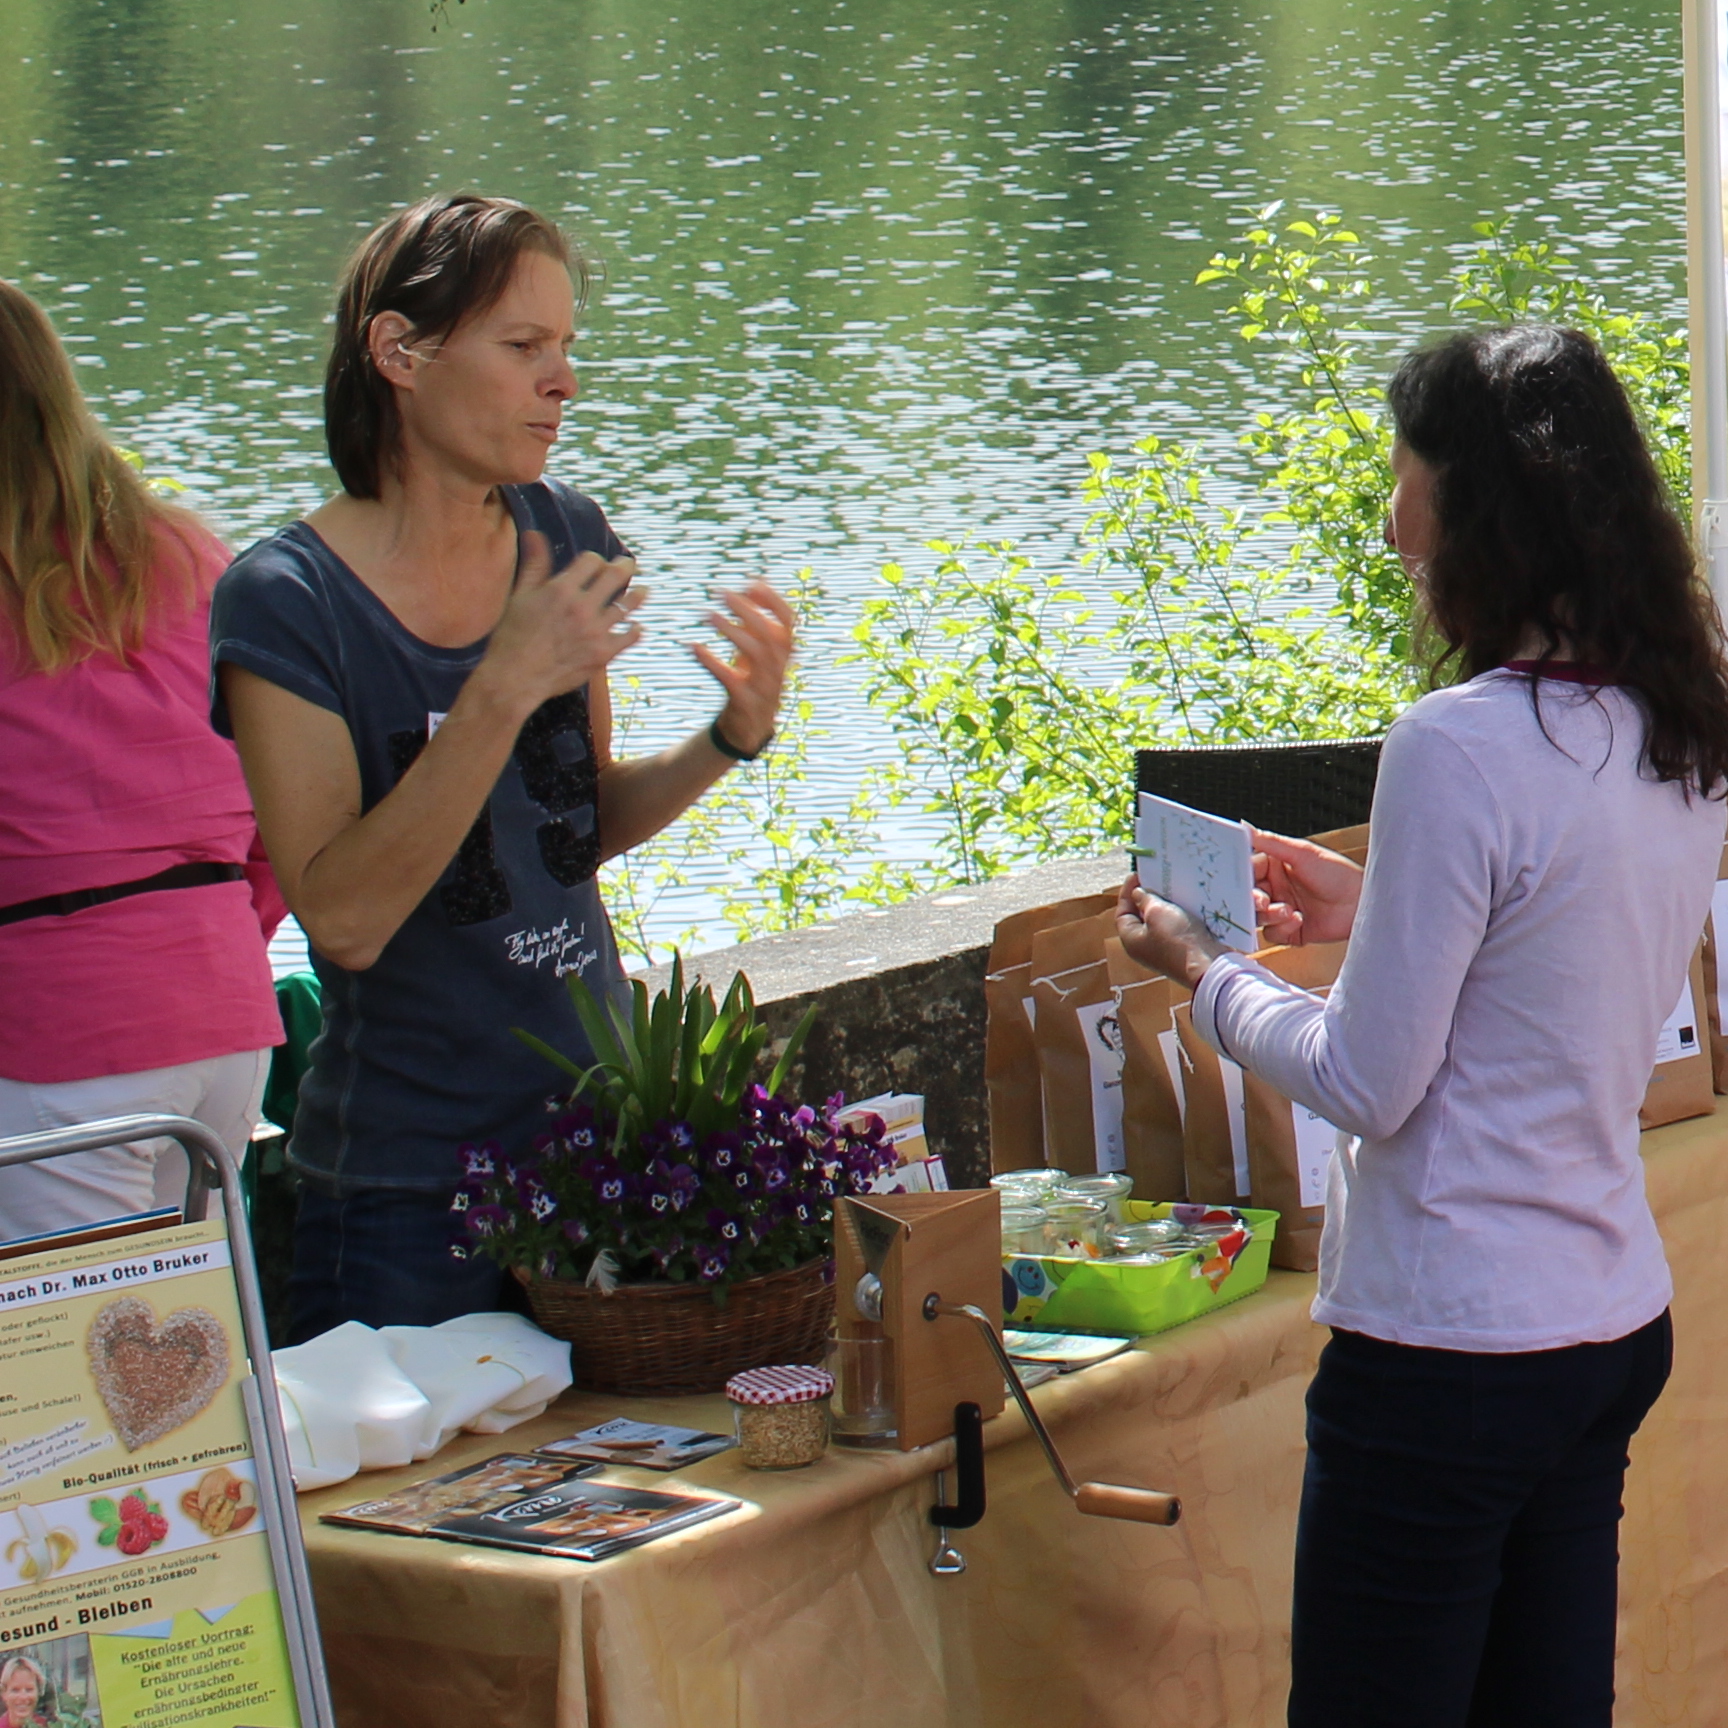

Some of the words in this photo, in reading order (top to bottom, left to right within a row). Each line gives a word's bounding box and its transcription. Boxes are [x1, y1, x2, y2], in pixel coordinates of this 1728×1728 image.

[42, 1280, 67, 1295] Dr.
[72, 1273, 107, 1289] Max
[112, 1265, 148, 1281] Otto
[153, 1252, 209, 1272] Bruker
[63, 1463, 140, 1490] Bio-Qualität
[143, 1456, 179, 1474] (frisch
[191, 1441, 247, 1464] gefrohren)
[4, 1574, 118, 1606] Gesundheitsberaterin
[121, 1567, 144, 1580] GGB
[147, 1563, 157, 1574] in
[160, 1550, 221, 1572] Ausbildung,
[9, 1598, 72, 1618] aufnehmen.
[75, 1587, 111, 1602] Mobil:
[113, 1566, 198, 1594] 01520-2808800
[77, 1596, 153, 1625] Bleiben
[121, 1638, 197, 1665] Kostenloser
[201, 1624, 255, 1646] Vortrag:
[166, 1652, 188, 1668] alte
[191, 1646, 214, 1662] und
[218, 1641, 247, 1656] neue
[140, 1657, 245, 1689] Ernährungslehre.
[154, 1684, 175, 1700] Die
[178, 1672, 235, 1694] Ursachen
[134, 1680, 259, 1719] ernährungsbedingter
